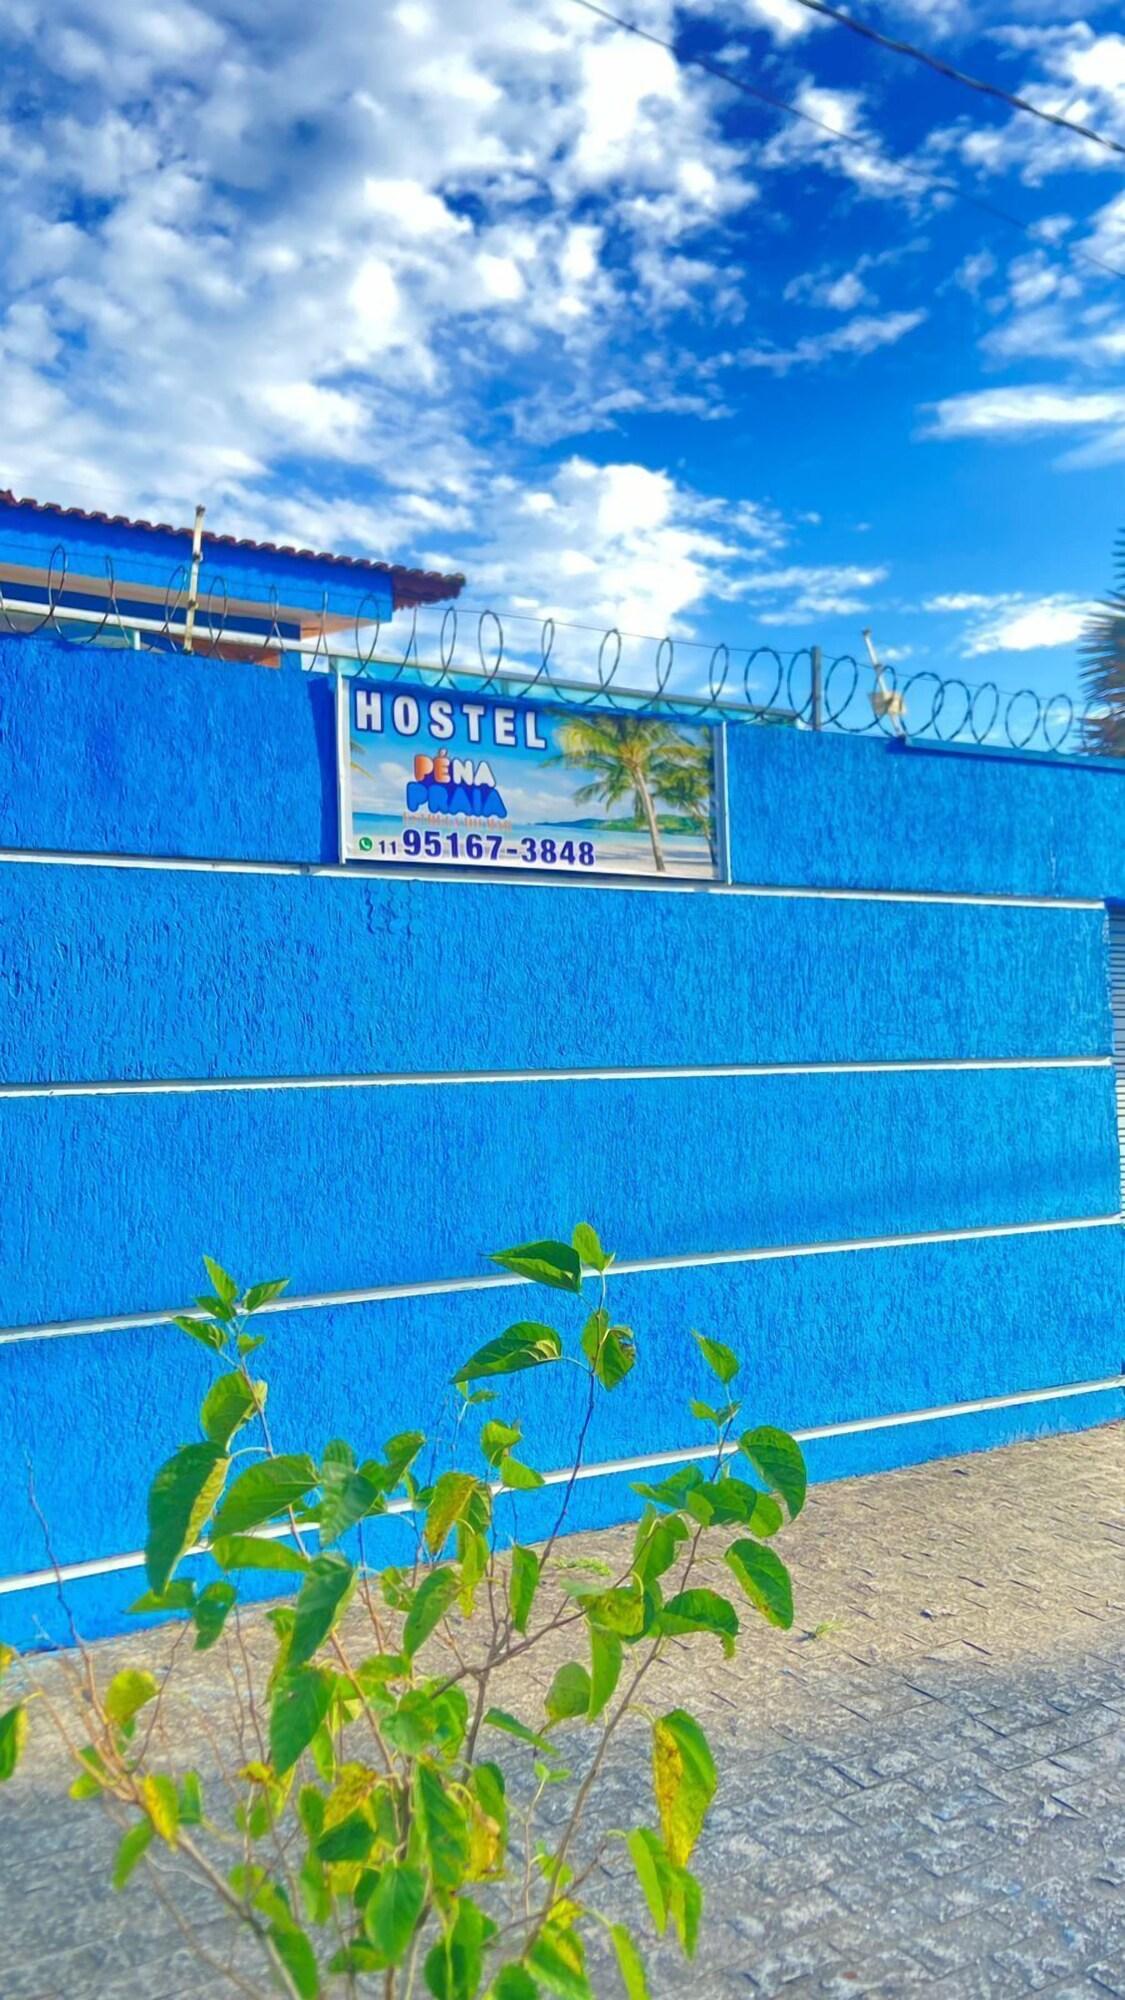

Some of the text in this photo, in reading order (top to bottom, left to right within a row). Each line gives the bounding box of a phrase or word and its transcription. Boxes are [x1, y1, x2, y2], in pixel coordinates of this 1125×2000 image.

[355, 690, 546, 749] HOSTEL
[406, 782, 508, 819] PRAIA
[379, 829, 595, 866] 11 95167-3848
